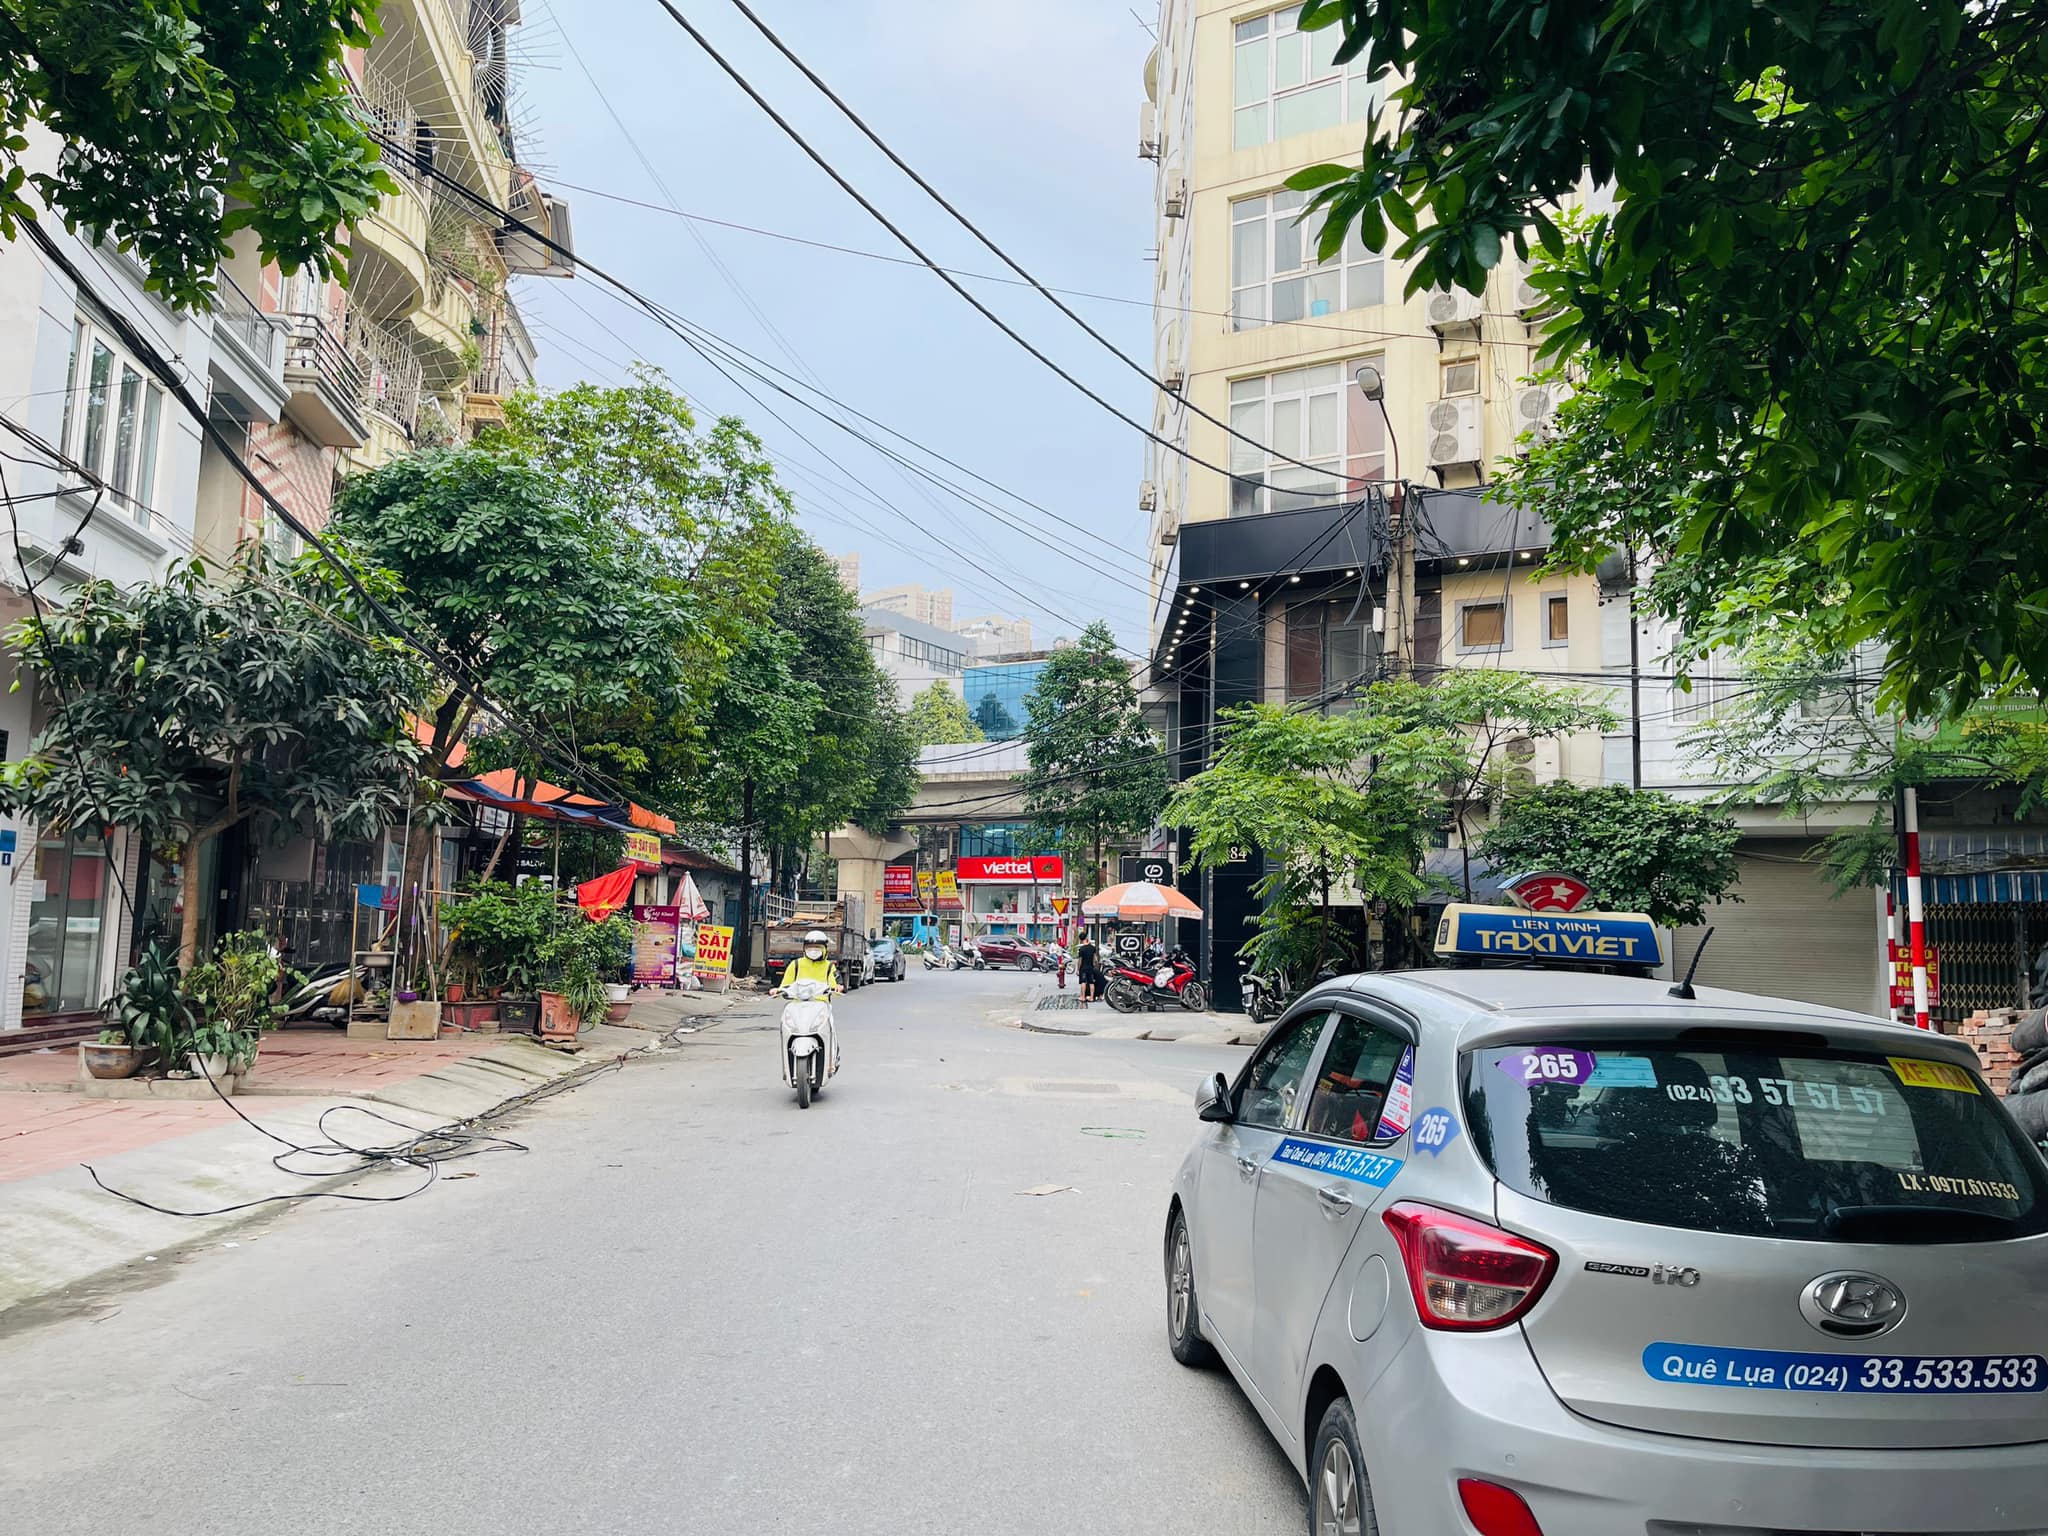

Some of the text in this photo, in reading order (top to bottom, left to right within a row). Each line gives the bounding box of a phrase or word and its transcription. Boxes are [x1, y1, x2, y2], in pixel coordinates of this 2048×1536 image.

[982, 861, 1033, 875] viettel
[1512, 919, 1601, 933] LIEN MINH
[698, 930, 731, 948] SẮT
[1475, 929, 1557, 953] TAXI
[698, 948, 728, 962] VỤN
[1898, 947, 1934, 960] CO
[1895, 961, 1937, 974] THÊ
[1522, 1053, 1578, 1080] 265
[1896, 1061, 1928, 1083] XE
[1665, 1075, 1886, 1116] (024) 33 57 57 57
[1416, 1112, 1449, 1146] 265
[1327, 1149, 1396, 1181] 33.57.57.57
[1587, 1261, 1701, 1288] GRAND i10
[1662, 1354, 2038, 1392] Quê Lụa (024) 33.533.533
